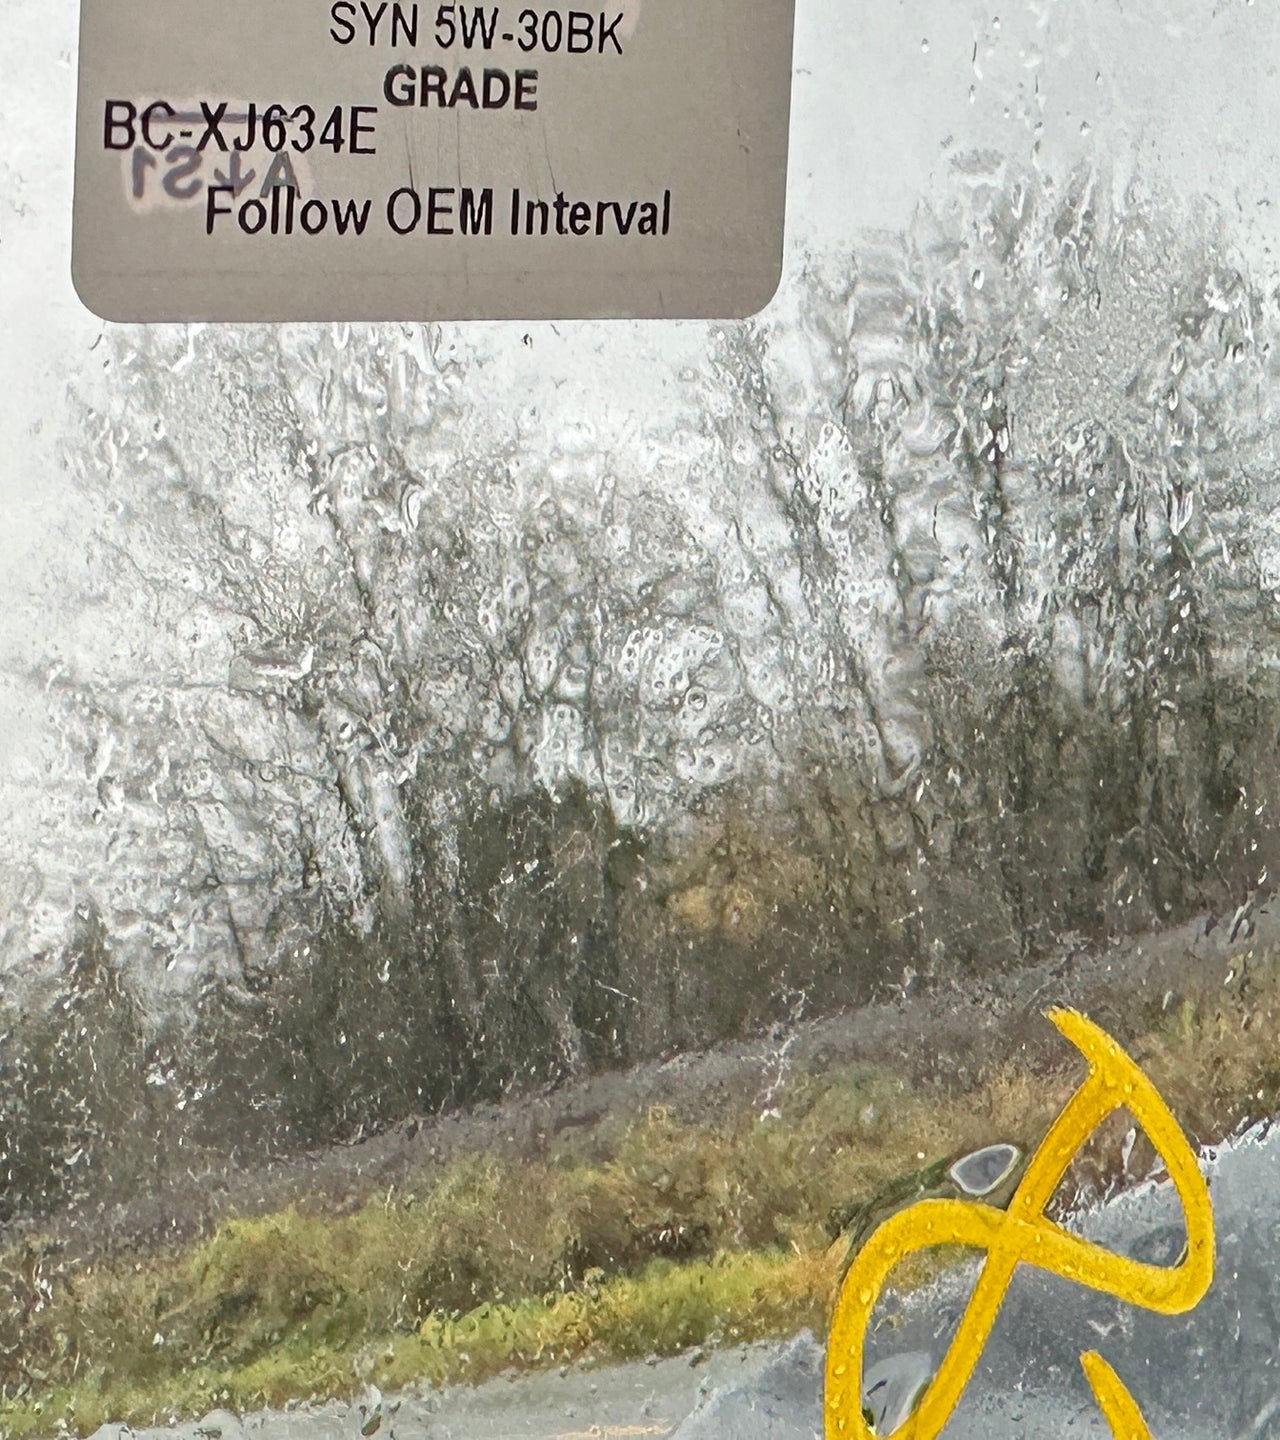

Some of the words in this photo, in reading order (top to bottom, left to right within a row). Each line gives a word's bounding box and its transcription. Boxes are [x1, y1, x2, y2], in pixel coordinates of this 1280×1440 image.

[329, 2, 418, 48] SYN
[434, 7, 624, 56] 5W-30BK
[384, 64, 539, 110] GRADE
[104, 101, 379, 155] BC-XJ634E
[205, 185, 371, 236] Follow
[387, 188, 492, 235] OEM
[510, 189, 671, 236] Interval
